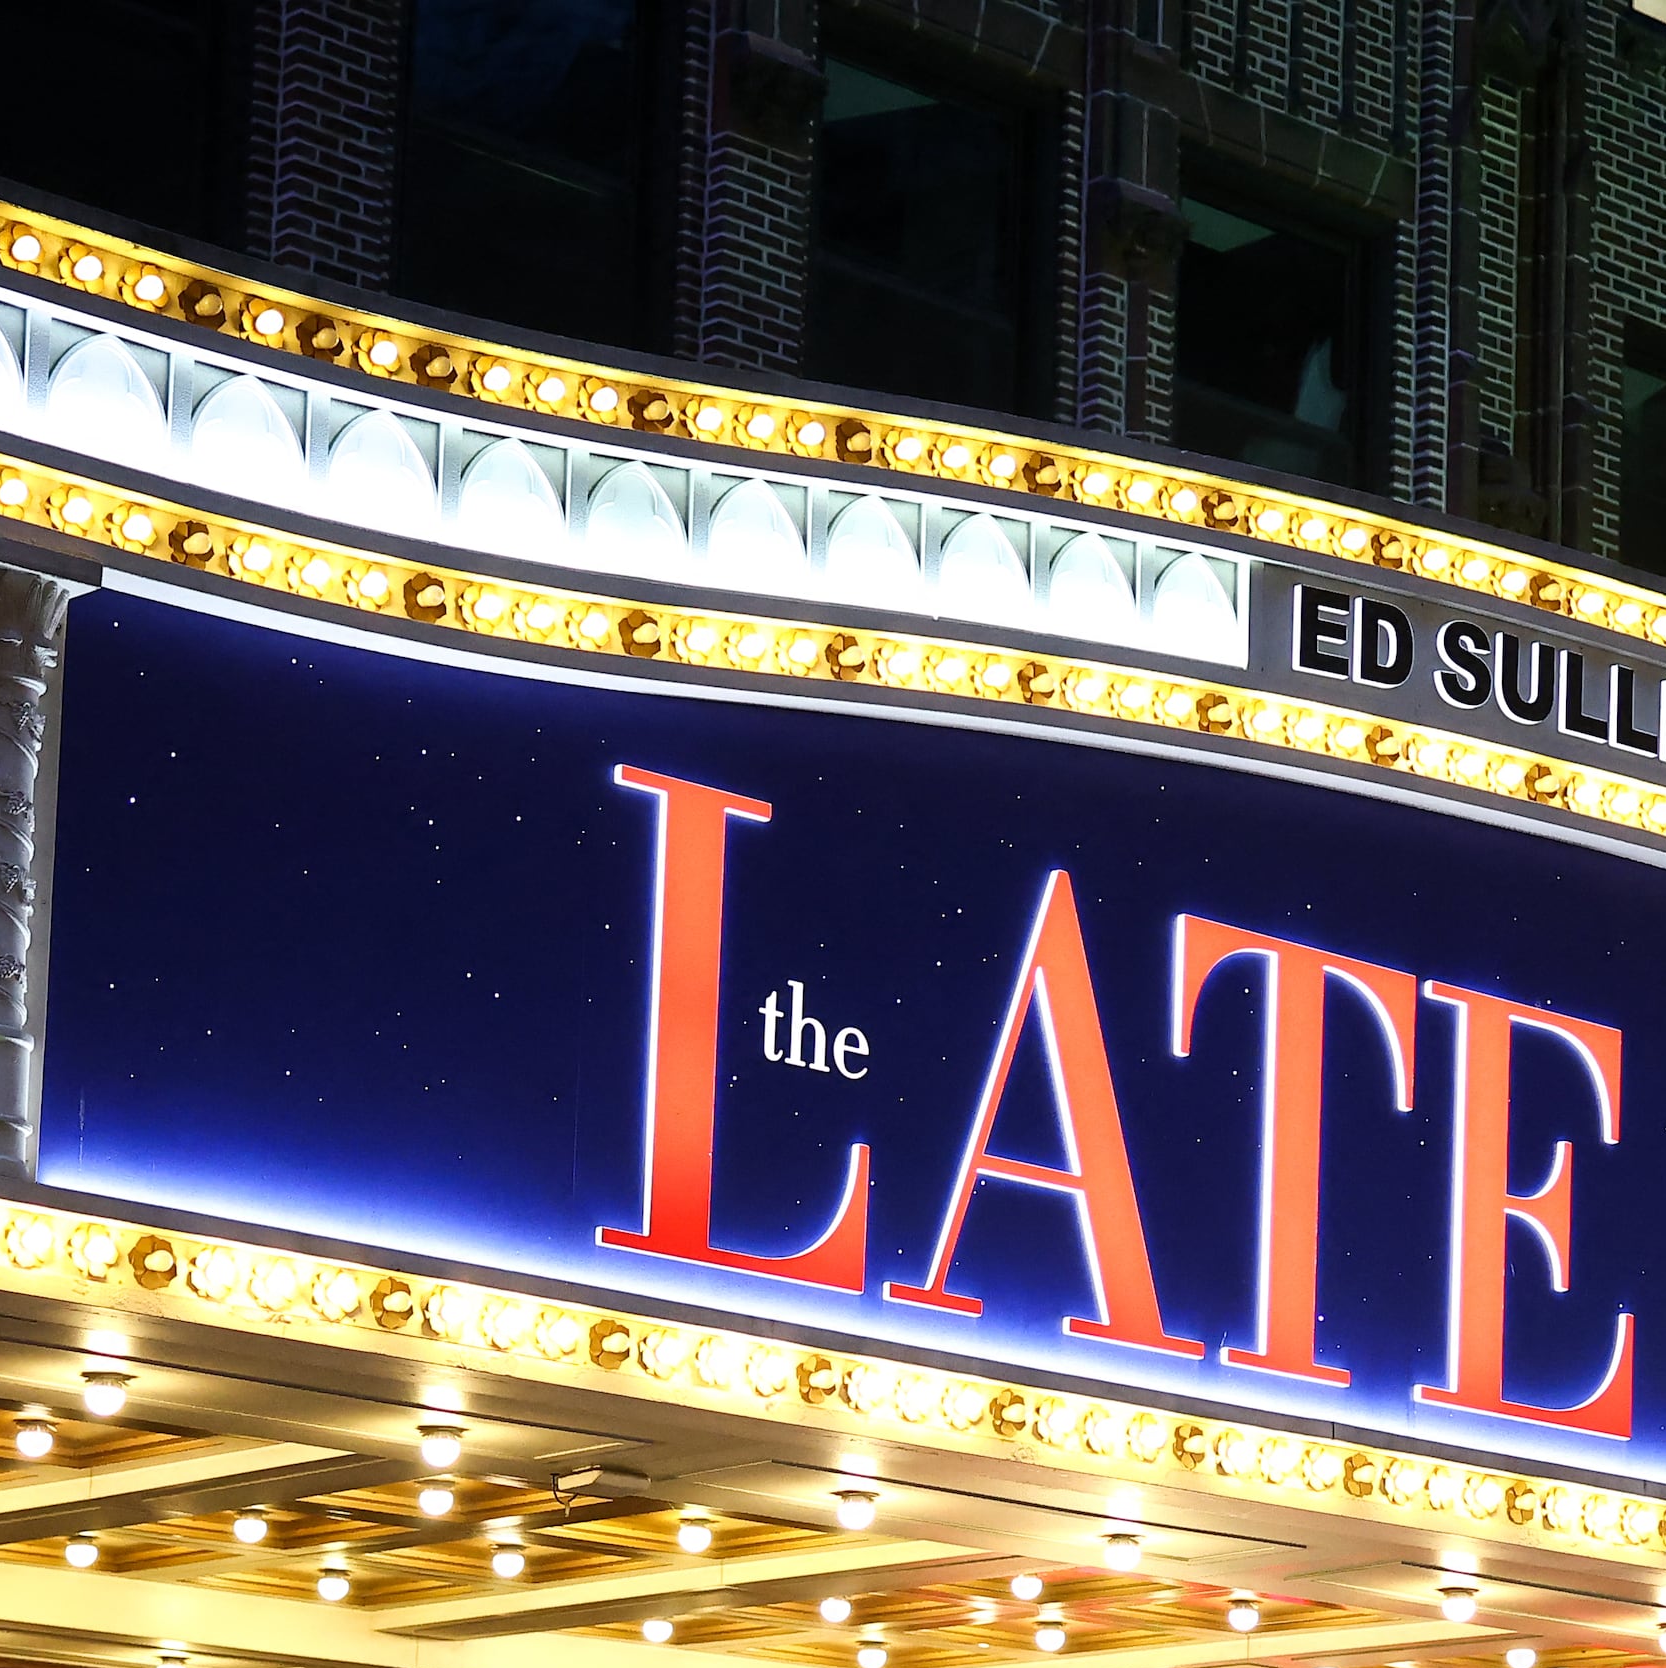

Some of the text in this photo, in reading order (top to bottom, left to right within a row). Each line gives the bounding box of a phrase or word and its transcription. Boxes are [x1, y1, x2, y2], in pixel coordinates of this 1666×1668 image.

[1292, 583, 1414, 689] ED
[758, 979, 871, 1080] the
[595, 763, 1635, 1442] LATE
